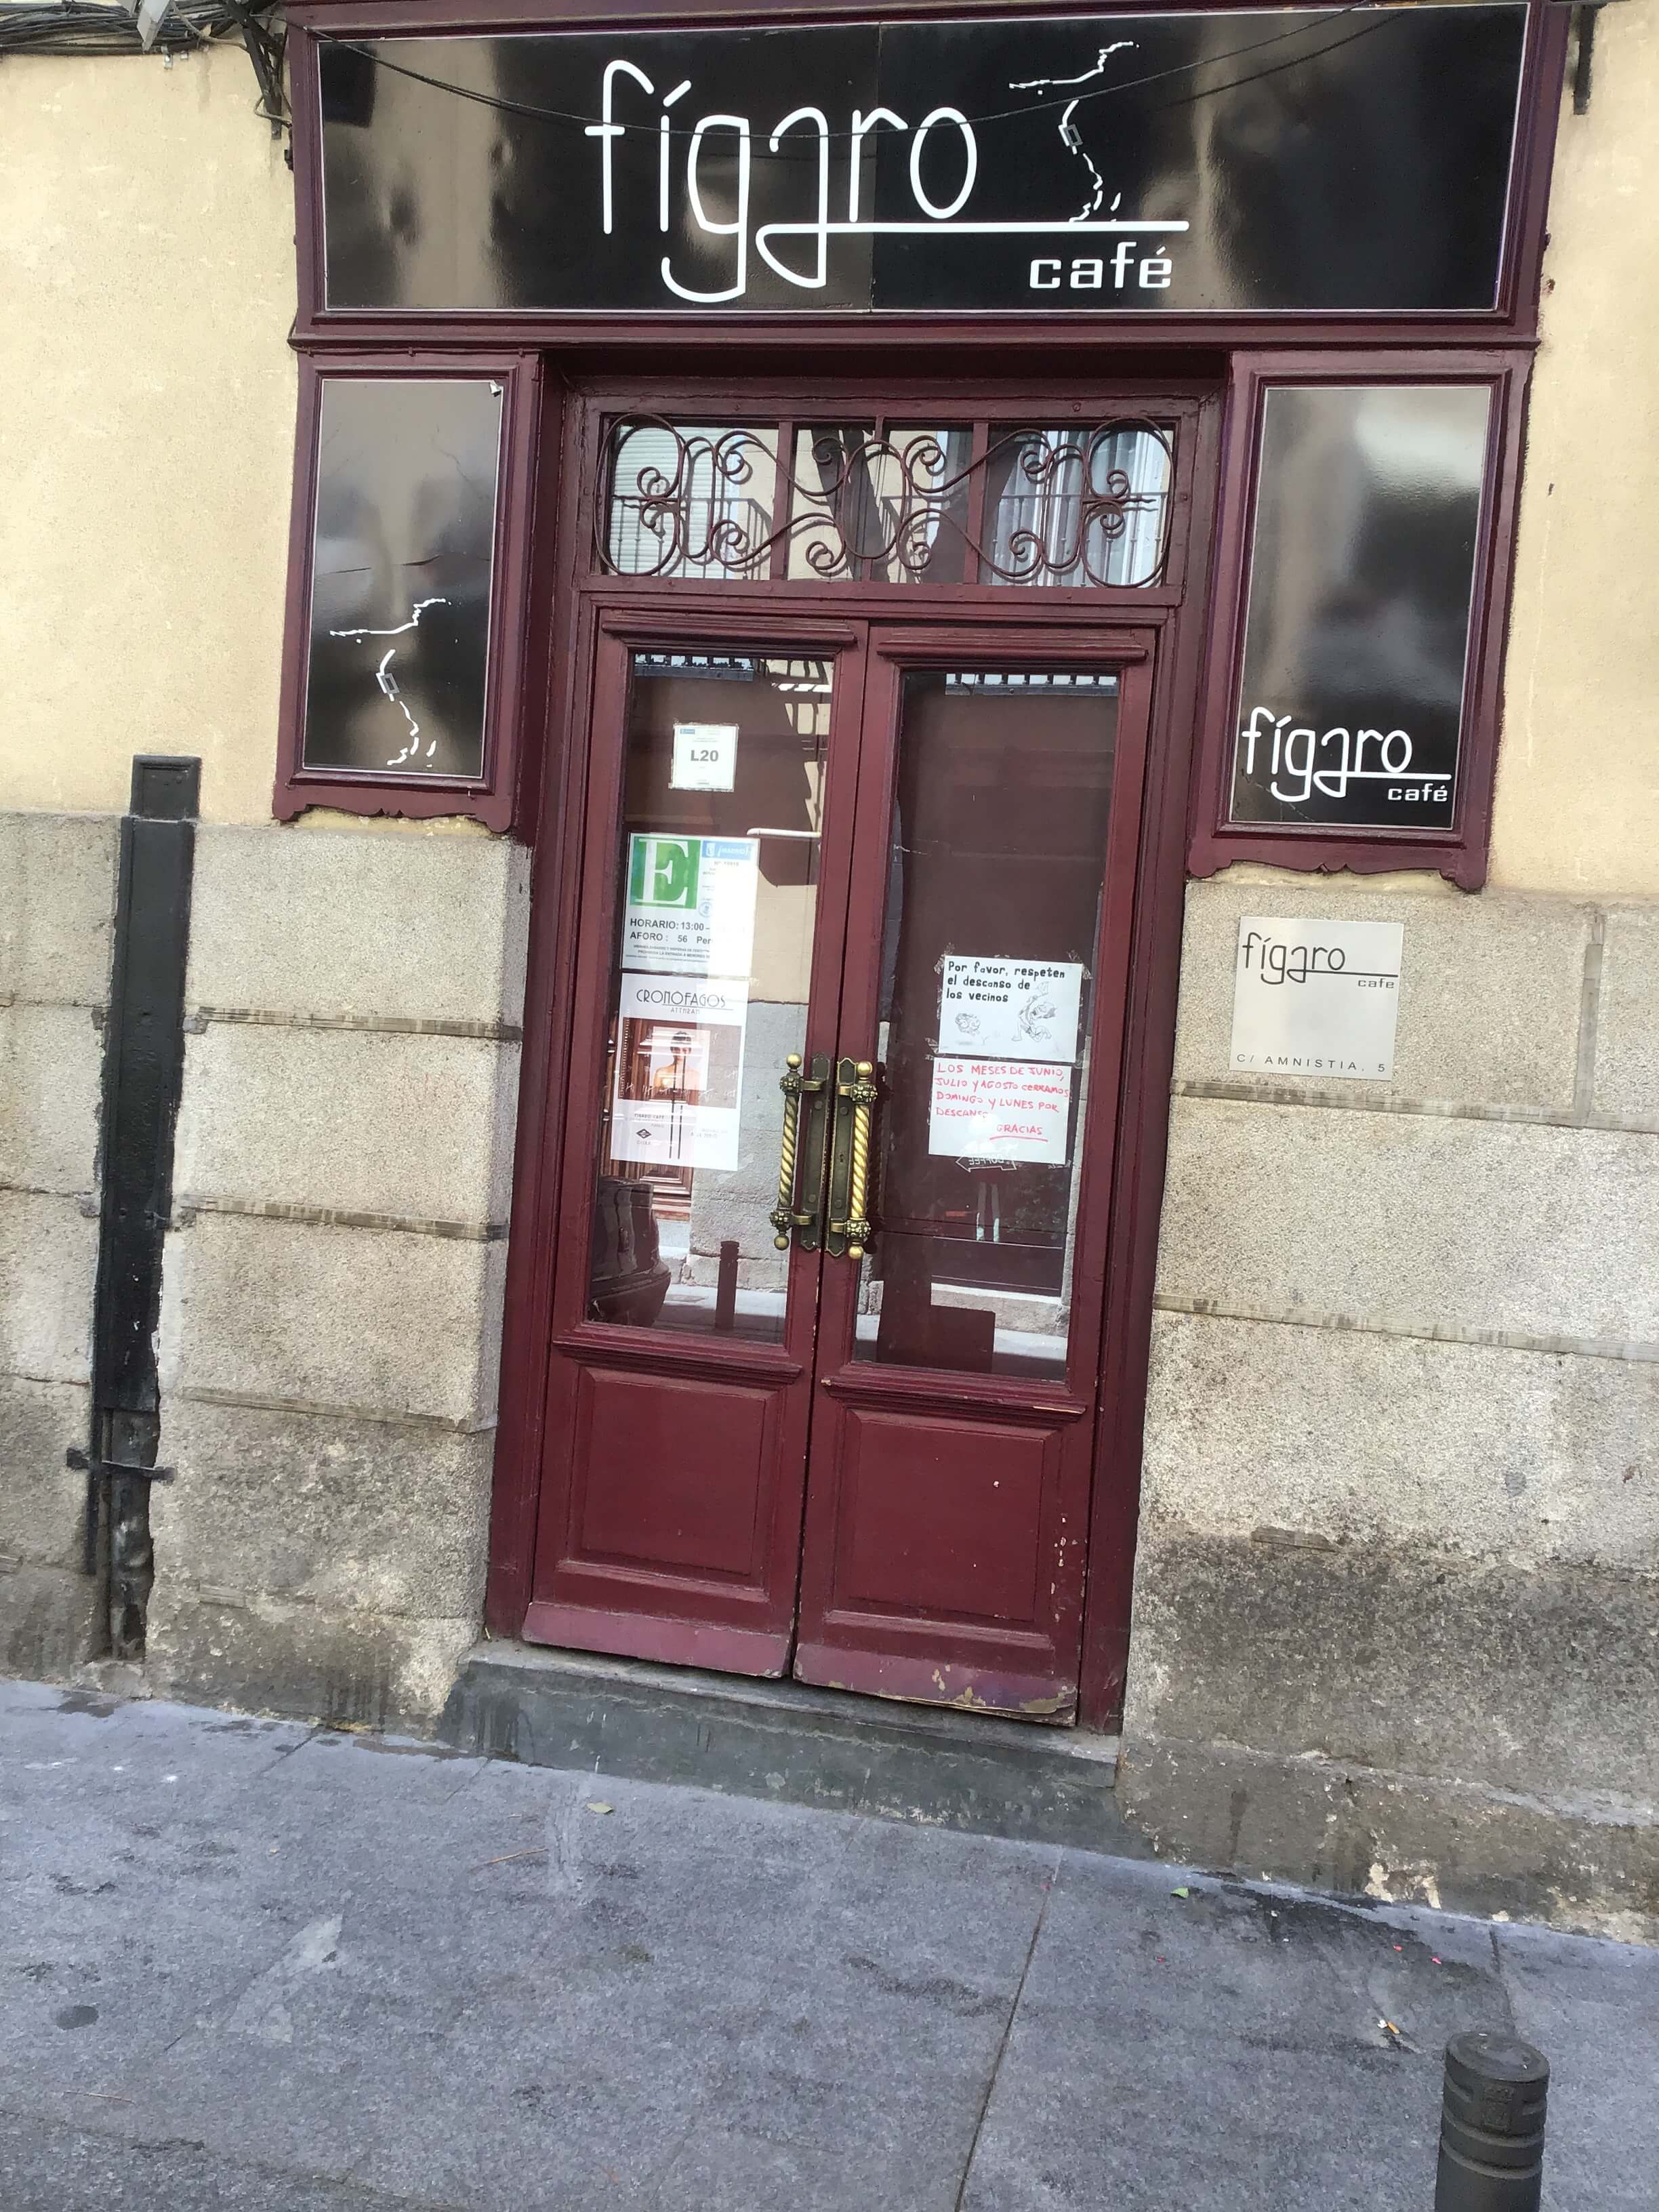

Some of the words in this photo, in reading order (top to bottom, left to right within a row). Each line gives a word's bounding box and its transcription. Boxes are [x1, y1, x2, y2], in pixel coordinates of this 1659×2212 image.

[1028, 245, 1172, 290] café
[690, 749, 719, 762] L20
[1387, 783, 1448, 802] café
[635, 838, 689, 906] E
[630, 918, 679, 930] HORARIO:
[681, 922, 704, 931] 13:00
[630, 931, 663, 941] AFORO
[678, 935, 688, 943] 56
[948, 961, 967, 972] Por
[974, 962, 1008, 976] favor,
[1014, 966, 1065, 981] respeten
[947, 975, 957, 985] el
[963, 975, 1011, 989] descanso
[1018, 979, 1030, 990] de
[1357, 978, 1395, 989] cafe
[946, 988, 962, 1000] los
[968, 991, 1008, 1002] vecinos
[1236, 1054, 1254, 1063] C/
[1378, 1064, 1385, 1072] 5
[937, 1063, 964, 1073] LOS
[970, 1065, 1007, 1076] MESES
[1009, 1066, 1025, 1075] DE
[1027, 1067, 1065, 1082] JUNIO,
[934, 1078, 968, 1087] JULIO
[972, 1080, 979, 1092] Y
[982, 1080, 1018, 1090] AGOSTO
[937, 1091, 983, 1104] DOMINGO
[988, 1098, 996, 1110] Y
[999, 1099, 1034, 1109] LUNES
[1038, 1102, 1060, 1113] POR
[996, 1124, 1044, 1136] GRACIAS
